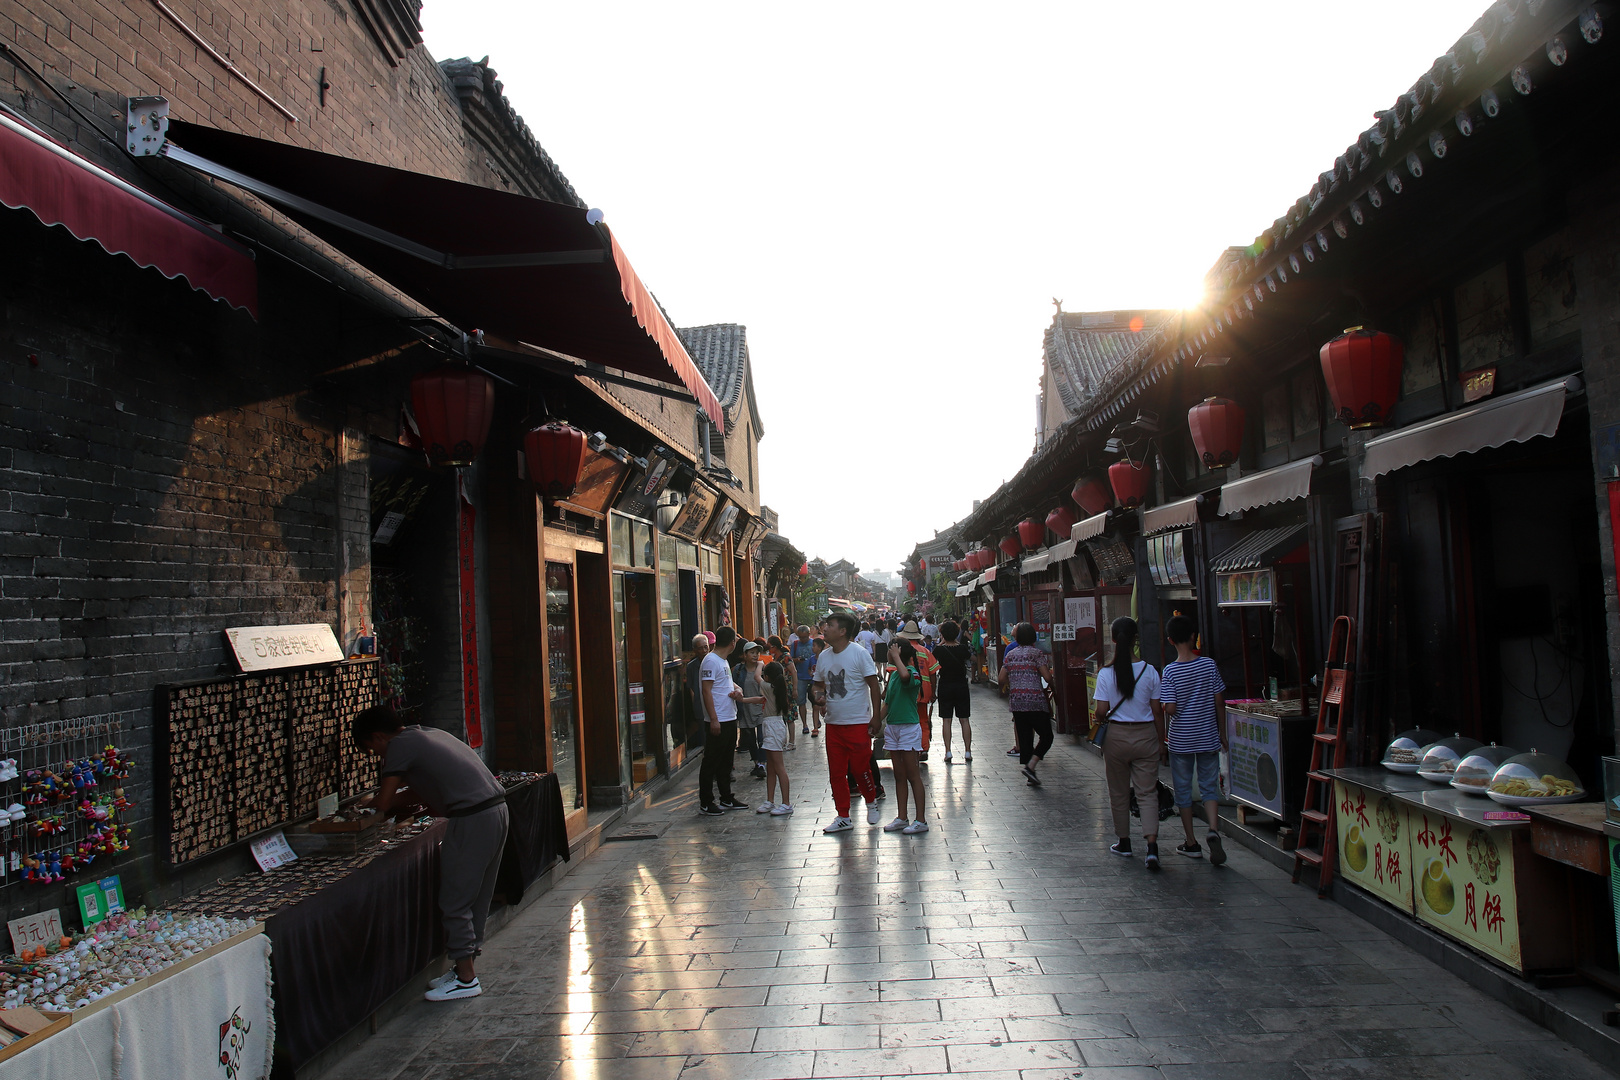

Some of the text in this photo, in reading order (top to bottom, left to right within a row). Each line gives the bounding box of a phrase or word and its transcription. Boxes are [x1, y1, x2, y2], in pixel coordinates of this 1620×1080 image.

[1055, 624, 1074, 632] 充电宝
[1341, 786, 1370, 832] 小米
[1417, 814, 1458, 868] 小米
[1374, 843, 1402, 893] 月饼
[1464, 882, 1505, 945] 月饼
